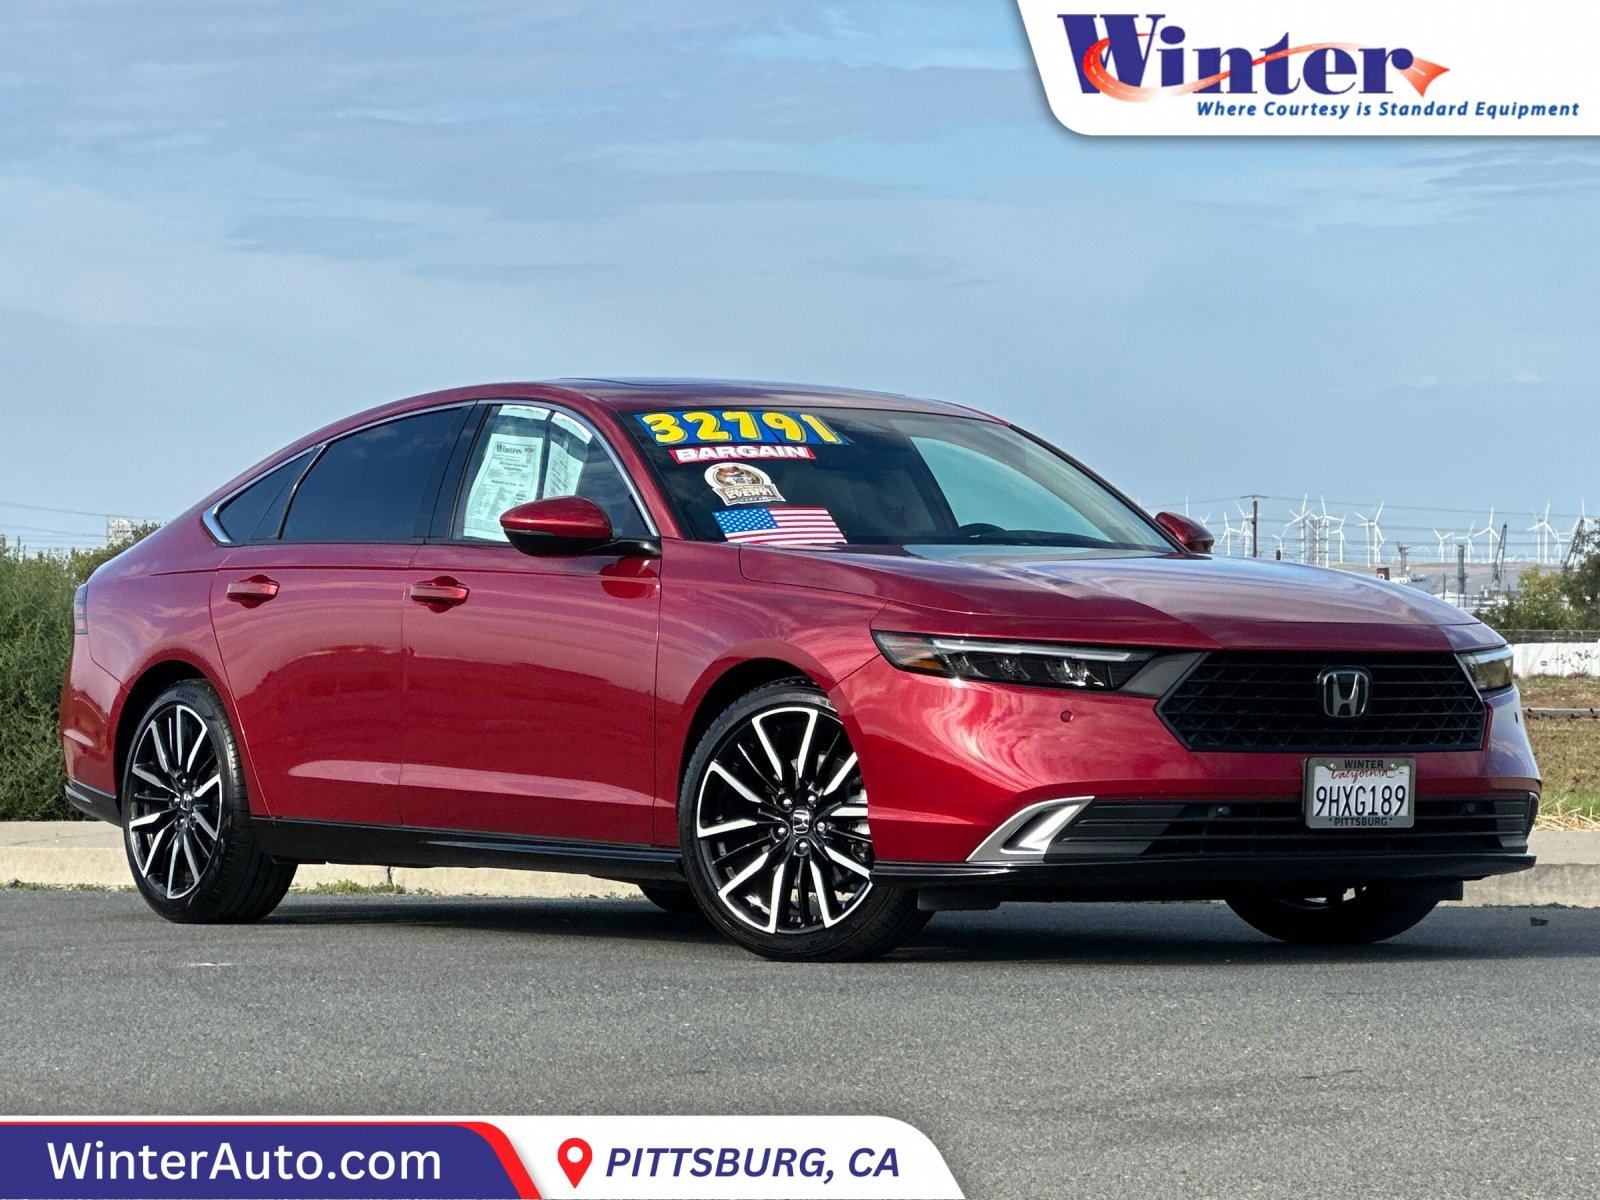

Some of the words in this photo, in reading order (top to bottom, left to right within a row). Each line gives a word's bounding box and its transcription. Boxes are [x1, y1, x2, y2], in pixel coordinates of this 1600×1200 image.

[641, 411, 840, 444] 32791
[673, 446, 808, 462] BARGAIN
[1344, 760, 1384, 769] WINTER
[1331, 769, 1394, 784] California
[1315, 785, 1406, 816] 9HXG189
[1334, 817, 1388, 827] PITTSBURG
